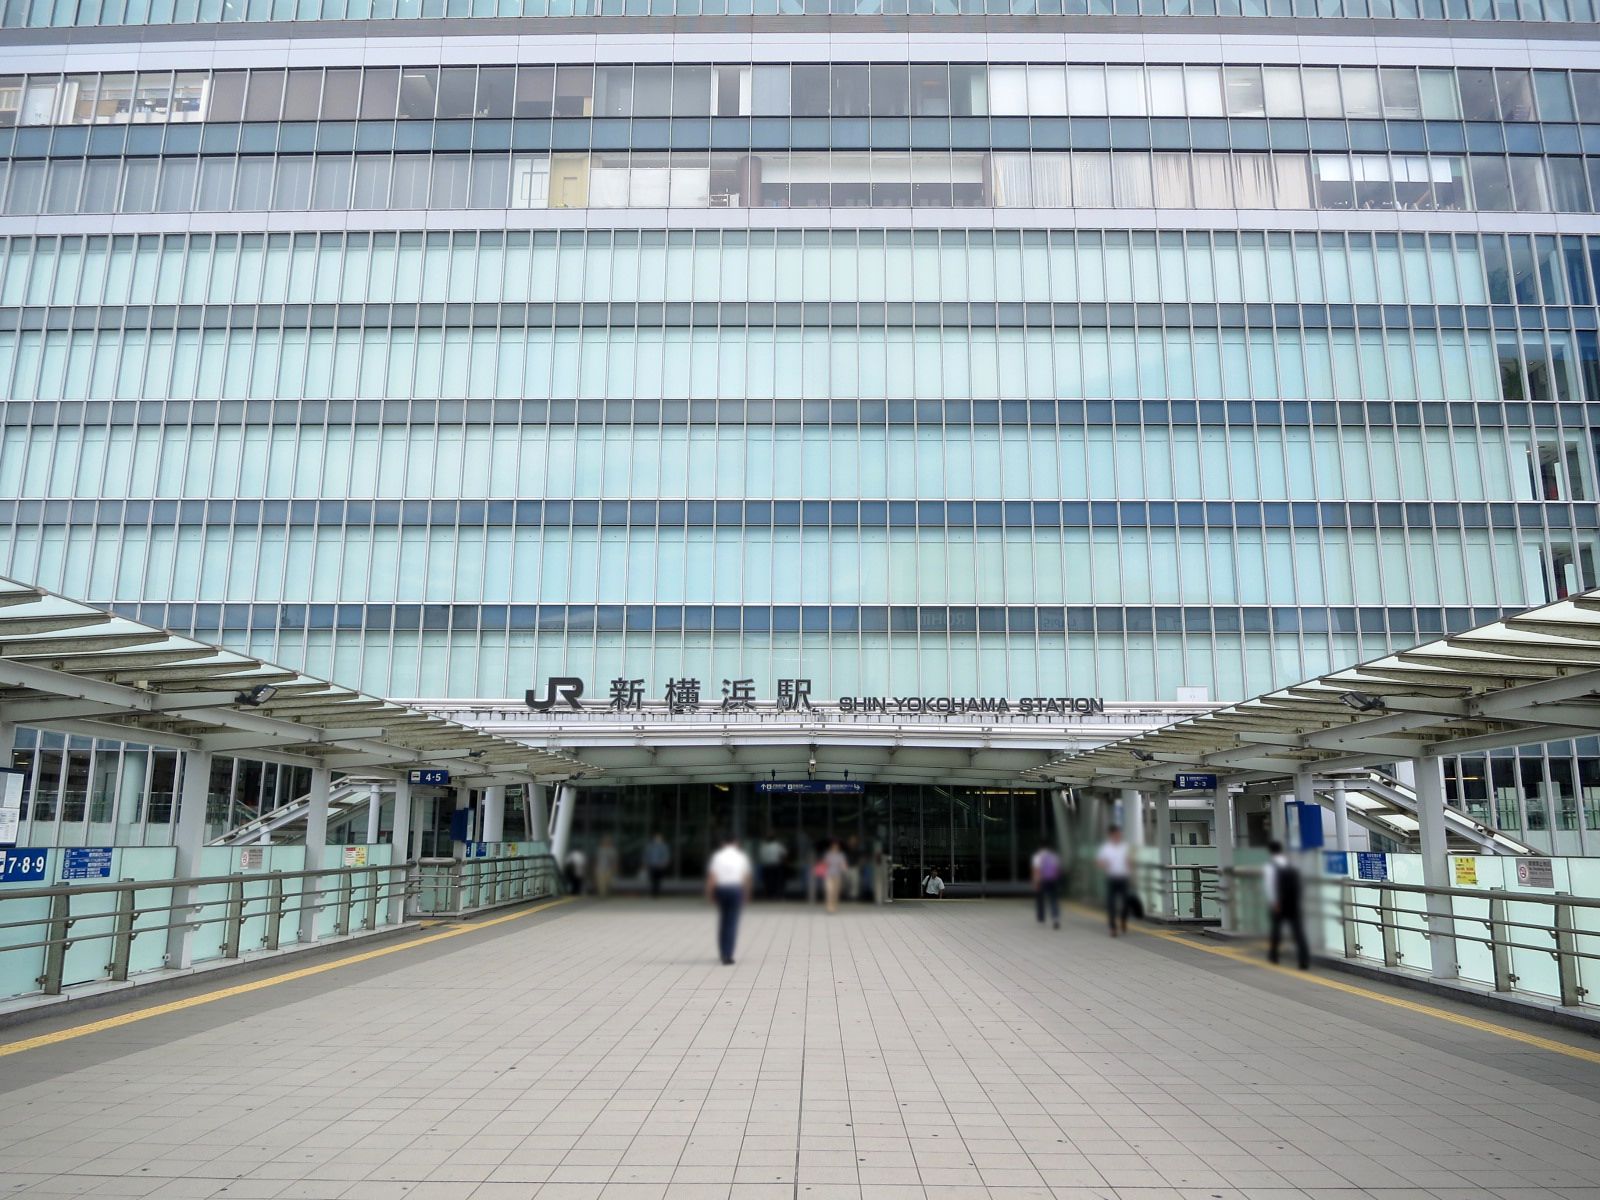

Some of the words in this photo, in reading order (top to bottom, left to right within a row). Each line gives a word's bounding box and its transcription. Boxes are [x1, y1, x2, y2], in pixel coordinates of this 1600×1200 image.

[525, 677, 584, 710] JR
[609, 677, 812, 711] 新横浜駅
[839, 697, 1011, 713] SHIN-YOKOHAMA
[1019, 697, 1104, 713] STATION
